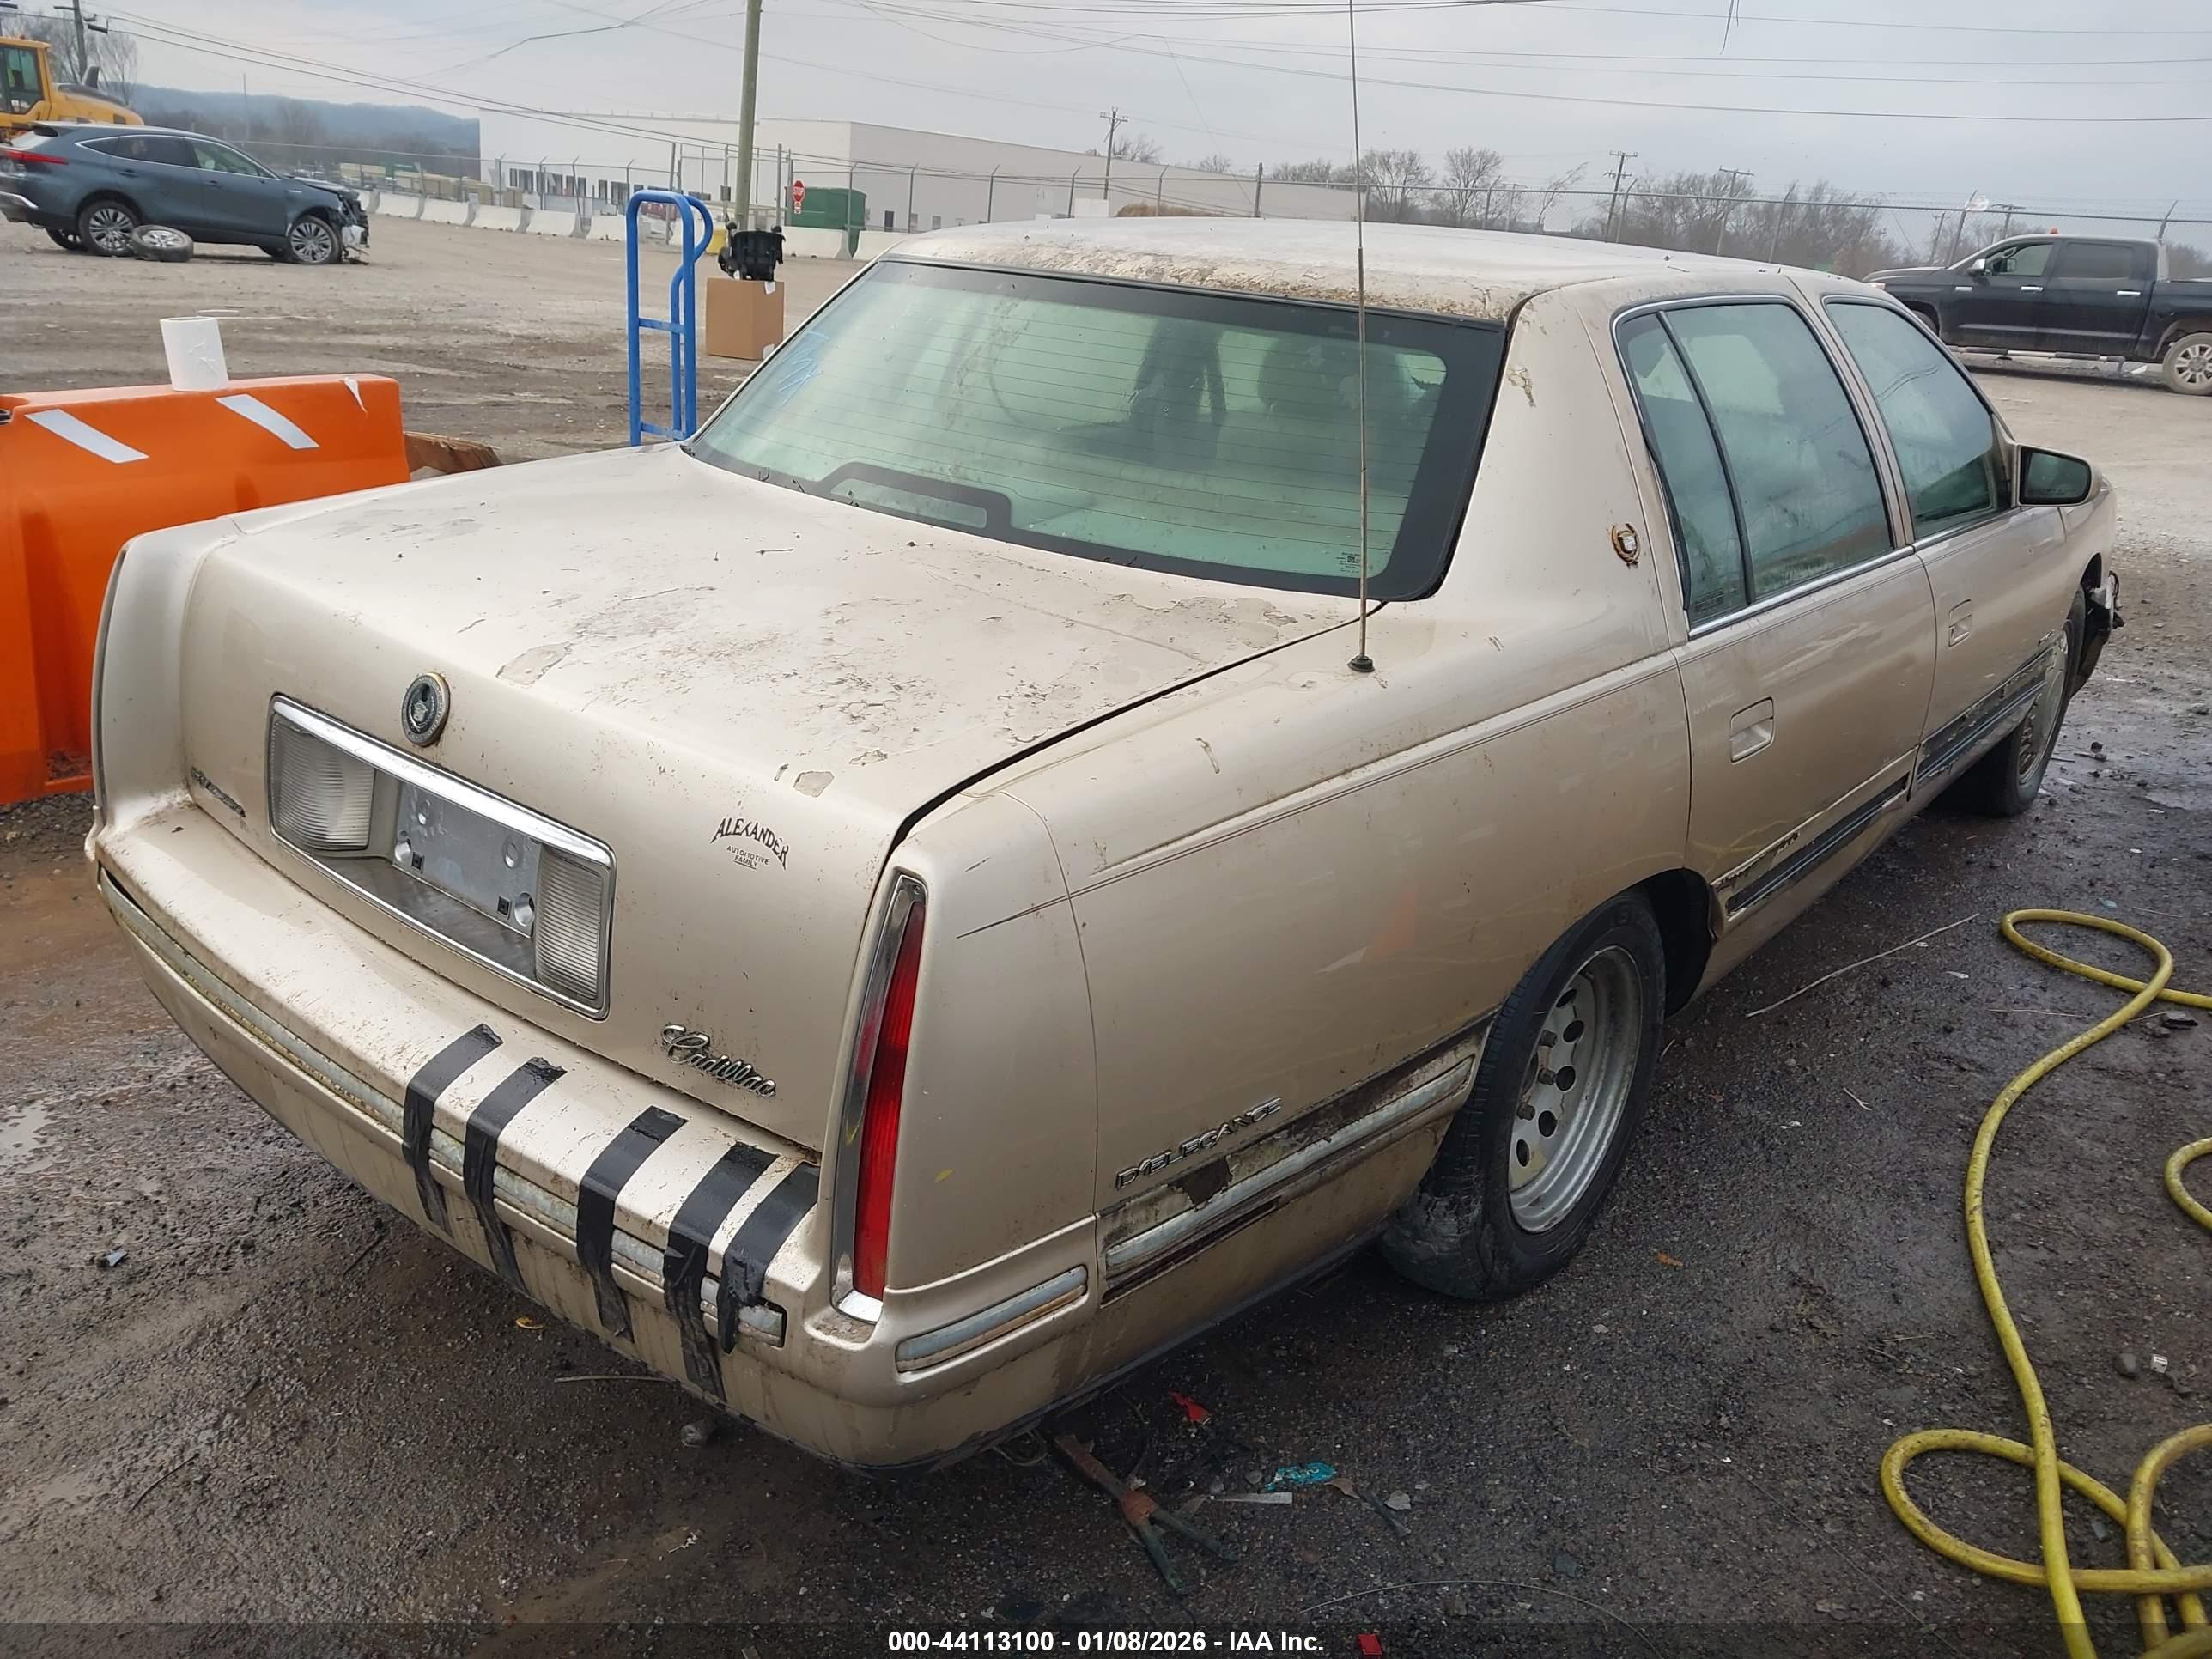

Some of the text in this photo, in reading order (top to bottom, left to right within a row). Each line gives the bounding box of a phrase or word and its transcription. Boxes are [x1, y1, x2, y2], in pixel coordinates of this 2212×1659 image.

[709, 817, 789, 871] ALEXANDER
[726, 845, 769, 866] AUTOMOTIVE
[734, 854, 758, 867] FAMILY
[660, 1024, 776, 1097] Cadillac
[1115, 1097, 1282, 1189] D'ELEGANCE
